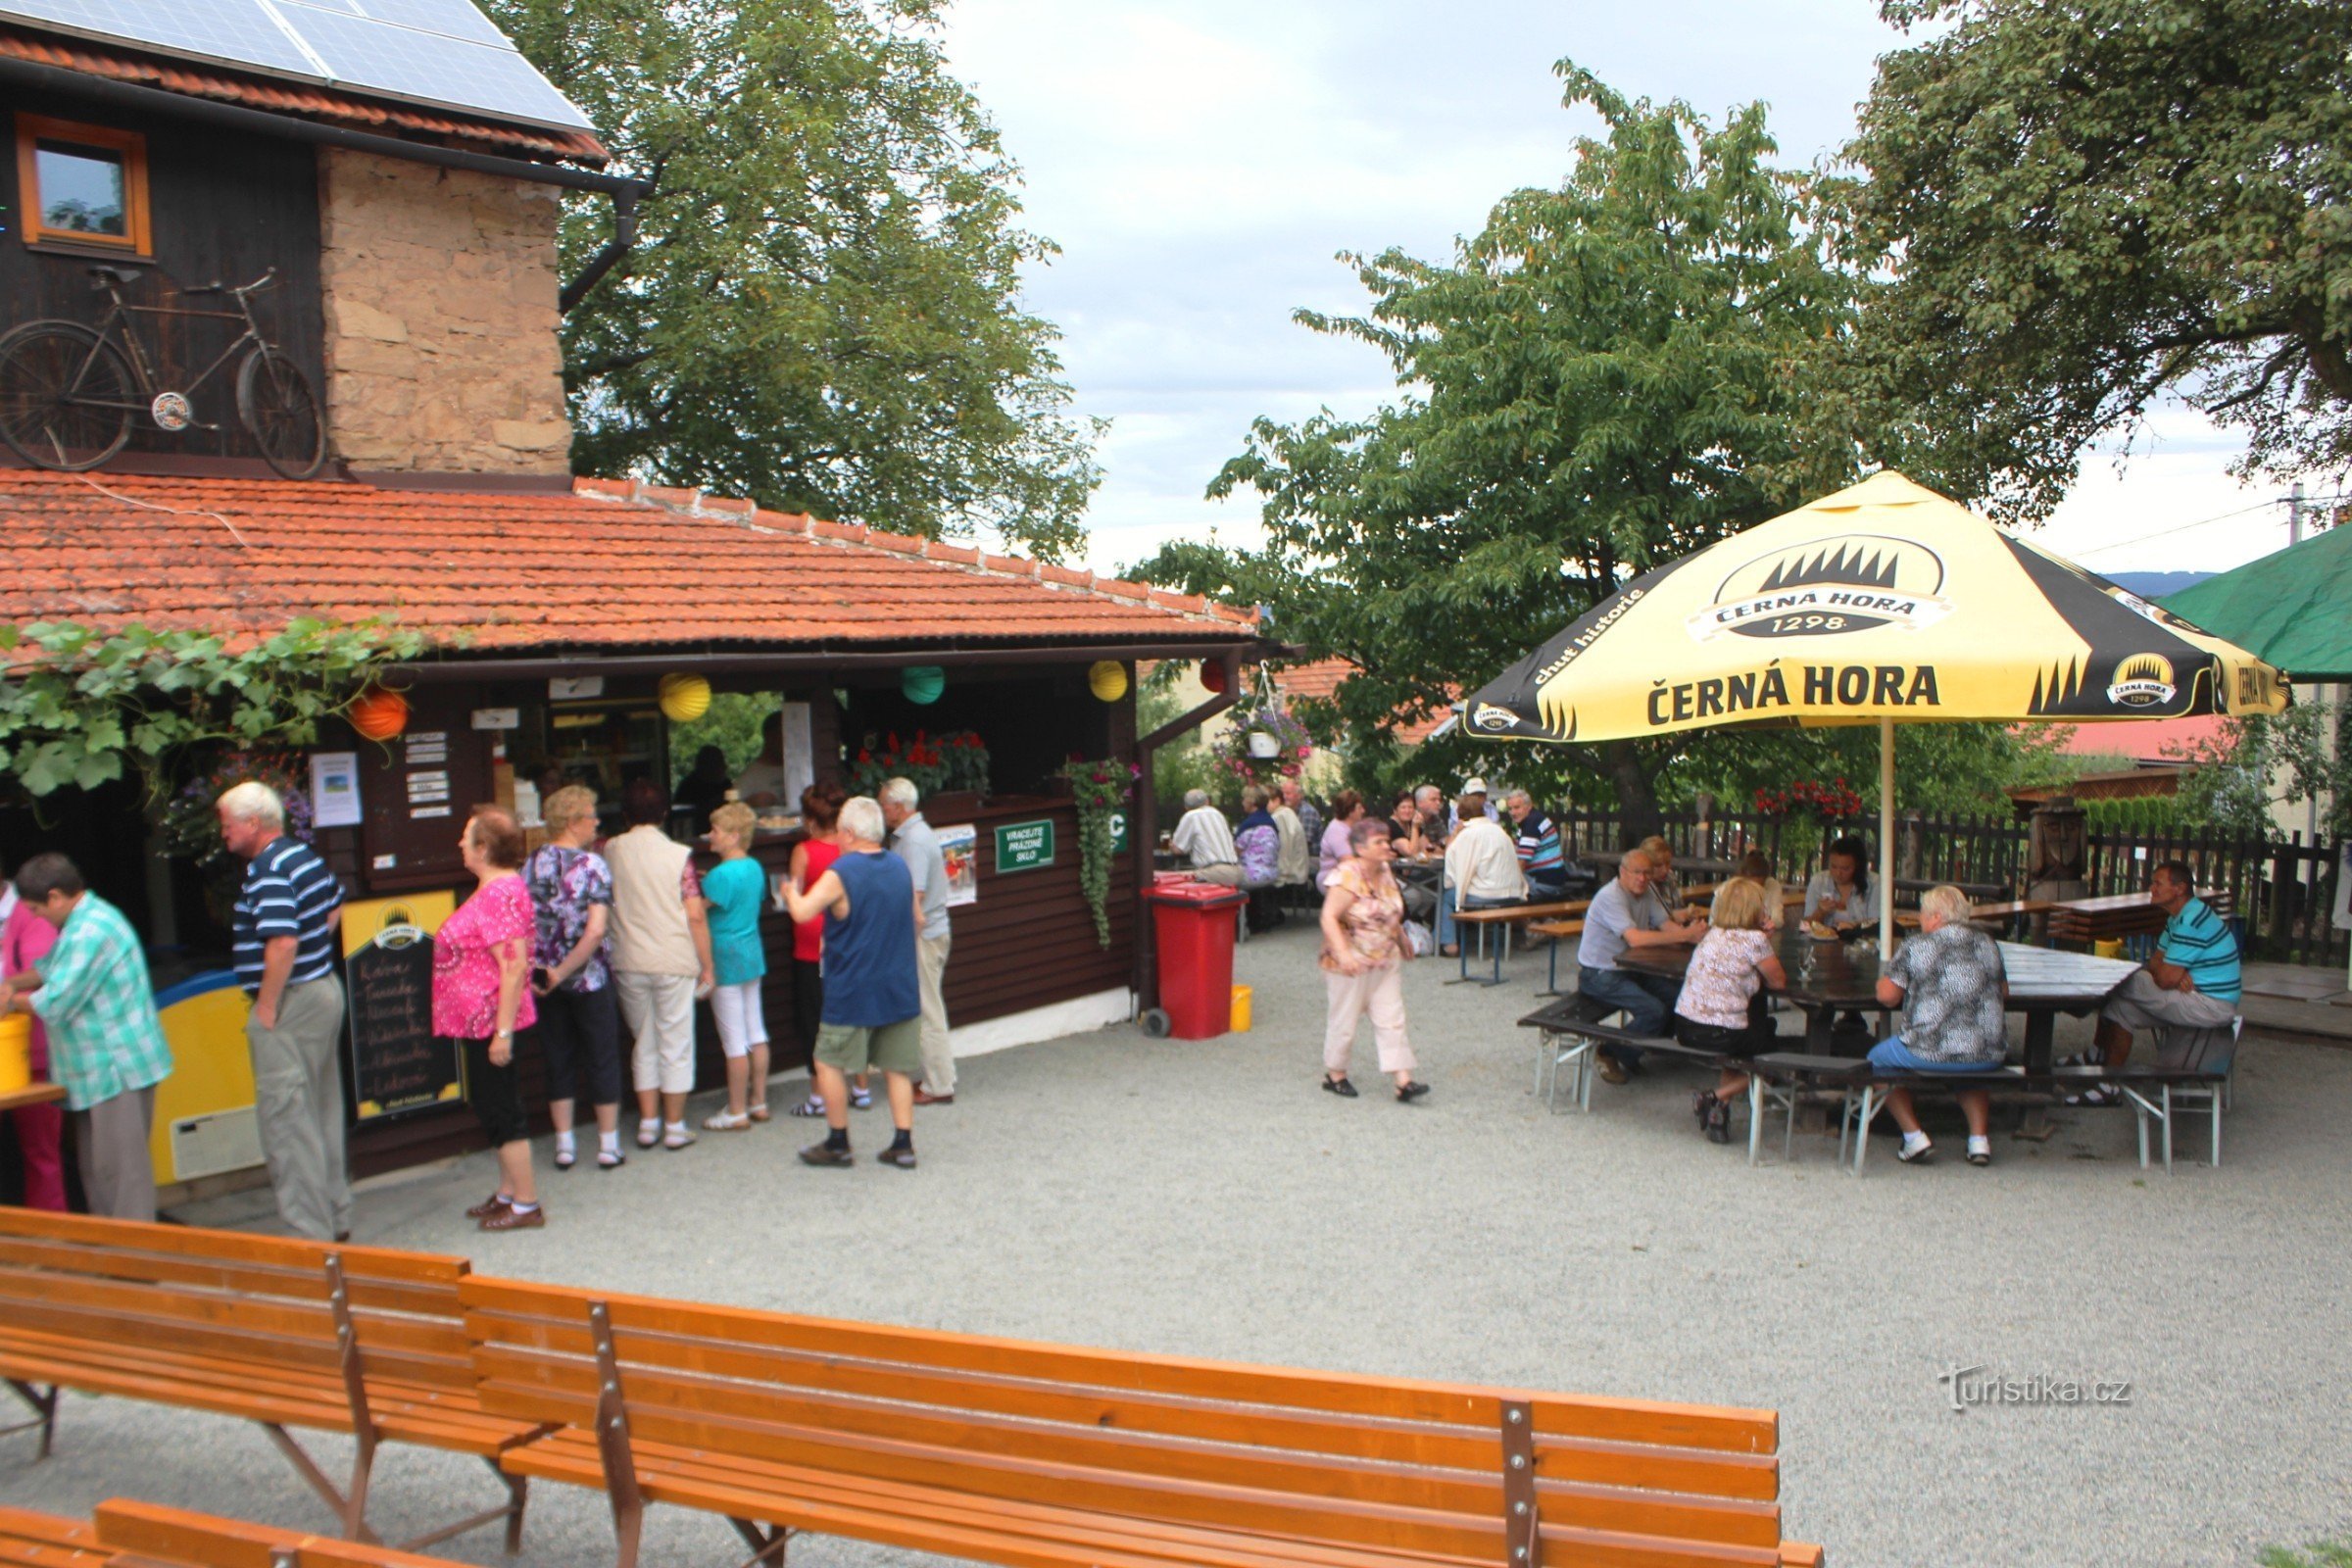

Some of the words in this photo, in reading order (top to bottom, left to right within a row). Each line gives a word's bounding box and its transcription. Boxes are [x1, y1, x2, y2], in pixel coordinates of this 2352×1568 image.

[1574, 588, 1643, 648] historie
[1716, 591, 1817, 622] ČERNÁ
[1829, 593, 1916, 614] HORA
[1772, 615, 1844, 633] 1298
[1647, 658, 1790, 725] ČERNÁ
[1803, 665, 1941, 706] HORA
[2143, 684, 2166, 694] HORA
